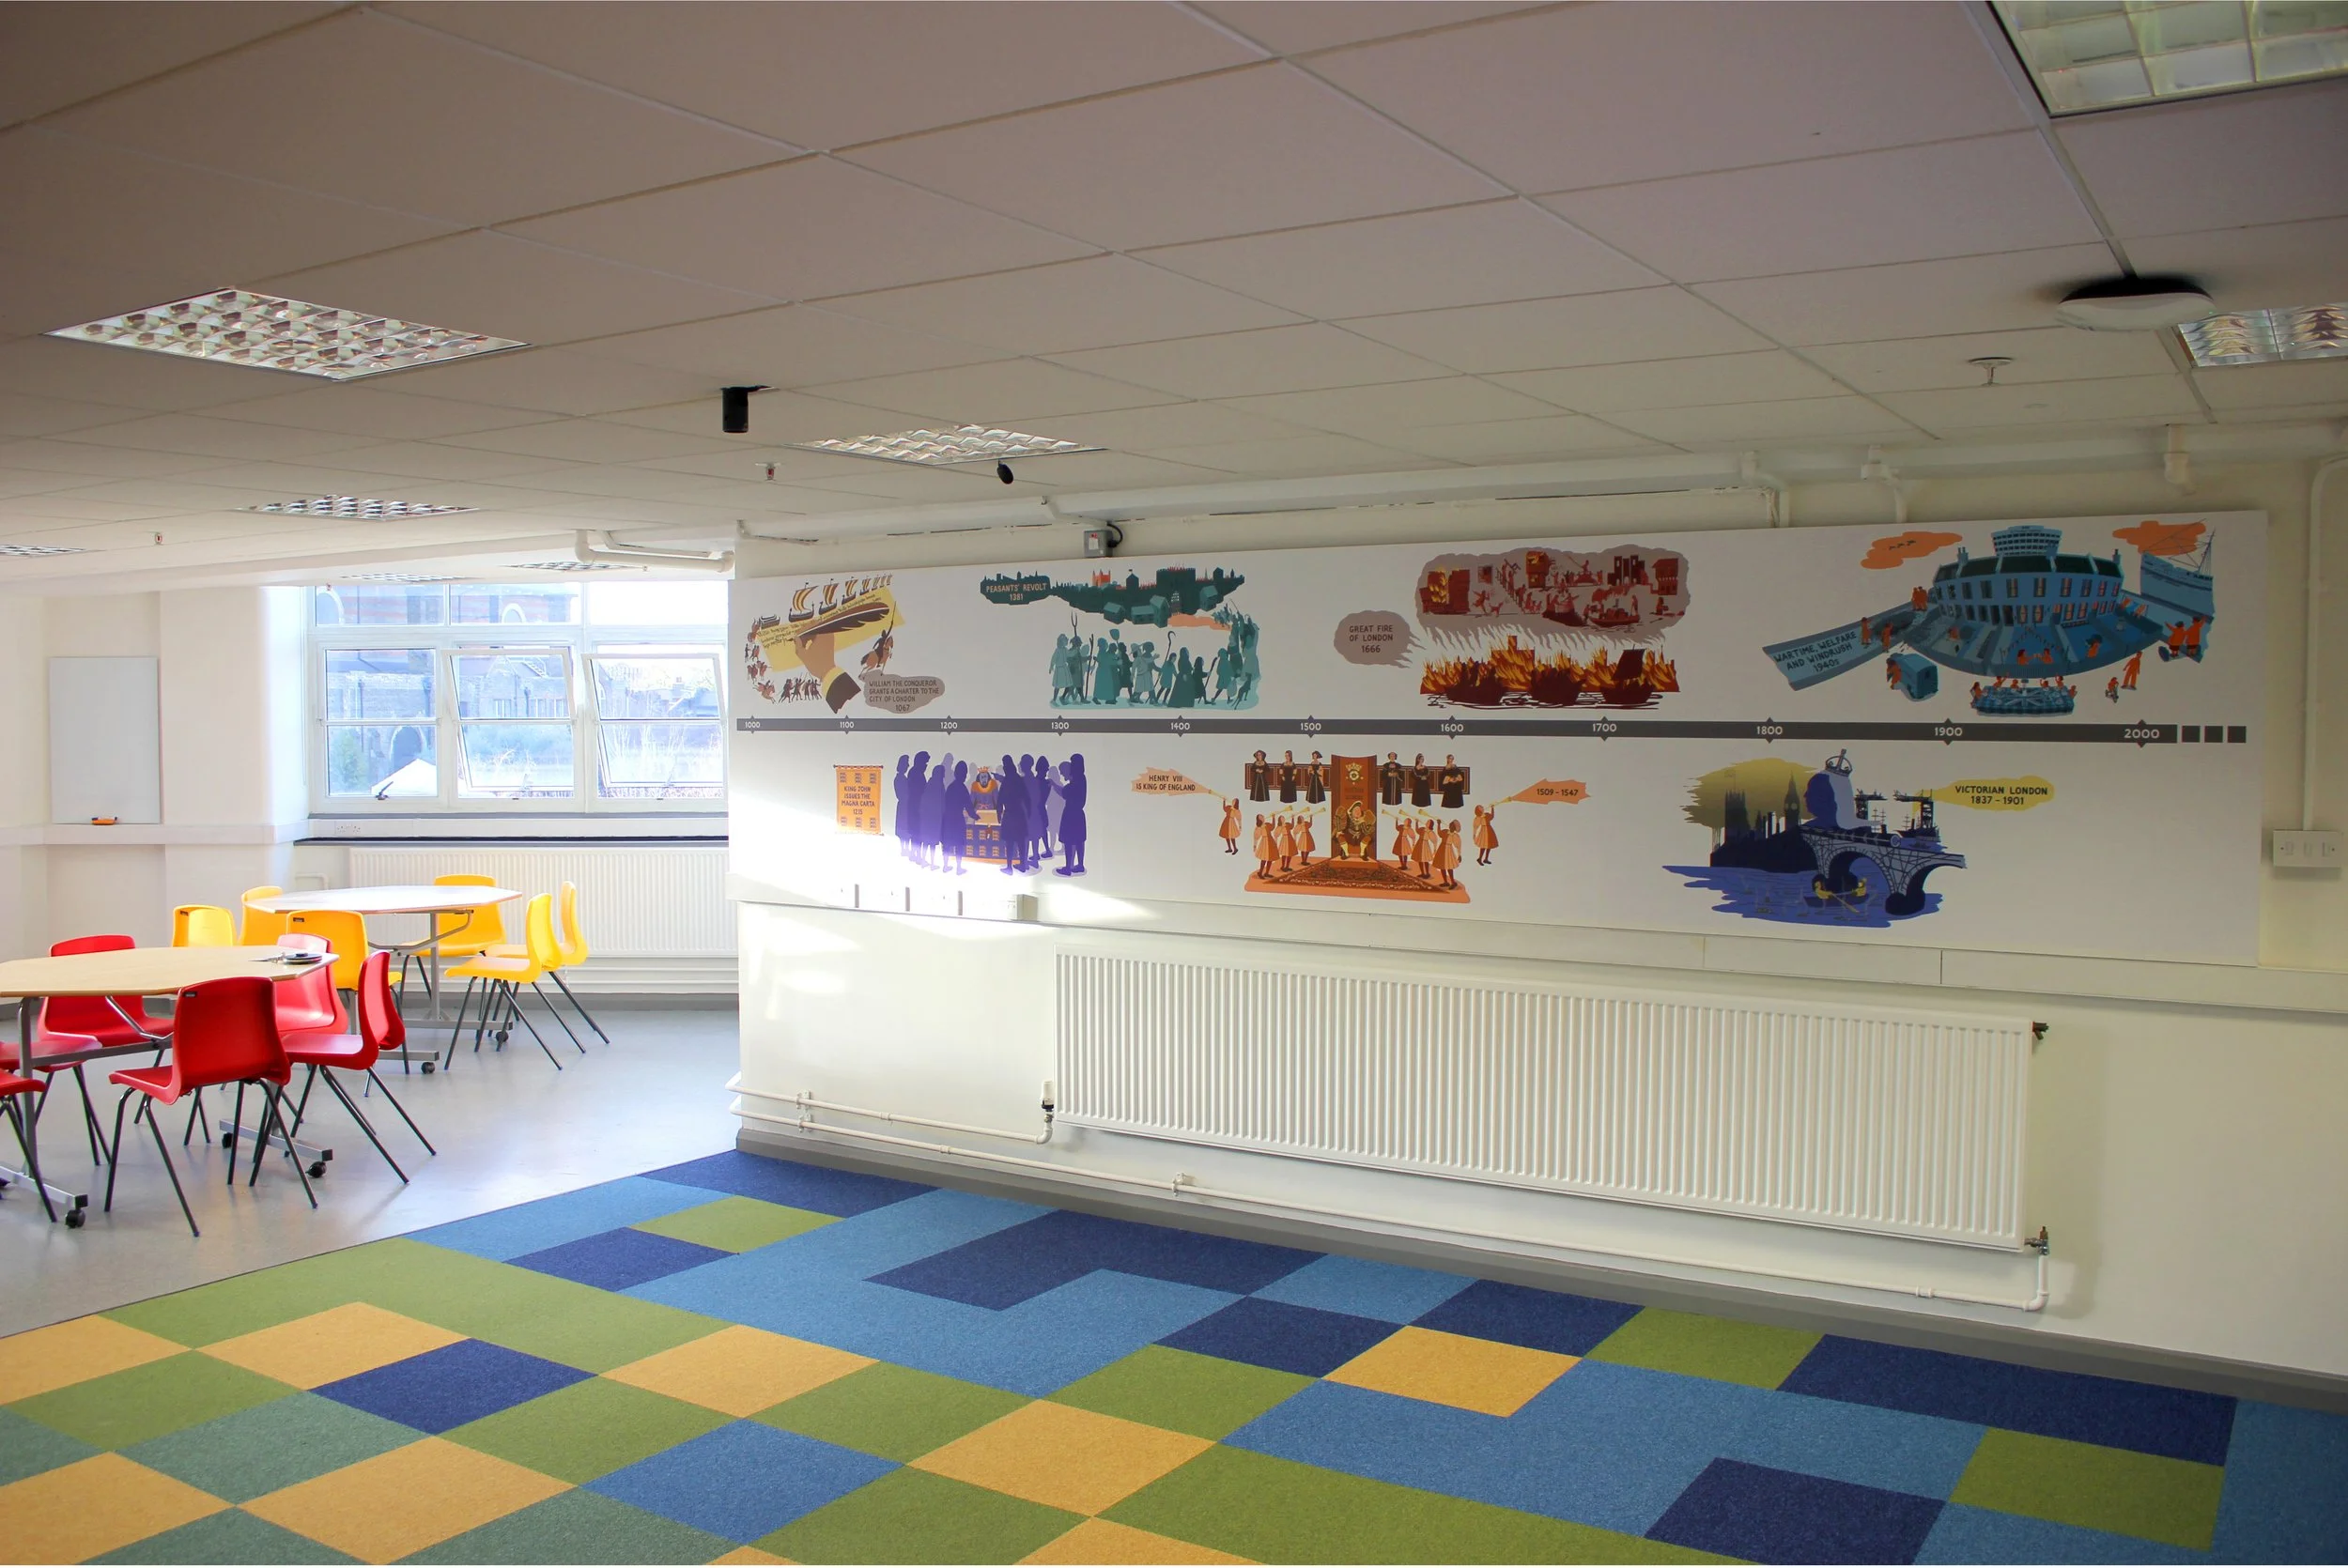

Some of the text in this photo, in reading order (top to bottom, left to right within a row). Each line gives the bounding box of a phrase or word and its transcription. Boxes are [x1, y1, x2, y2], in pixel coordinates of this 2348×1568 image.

[1023, 583, 1047, 592] REVOLT
[1817, 631, 1857, 651] WELFARE
[1786, 642, 1853, 670] AND WINDRUSH
[1813, 658, 1840, 672] 1940s
[940, 721, 957, 730] 1200
[1051, 721, 1069, 730] 1300
[1170, 722, 1190, 730] 1400
[1300, 722, 1321, 730] 1500
[1440, 723, 1464, 731] 1600
[1592, 723, 1616, 731] 1700
[1756, 725, 1784, 735] 1800
[1934, 727, 1963, 736] 1900
[2124, 729, 2160, 739] 2000
[2003, 796, 2024, 805] 1901
